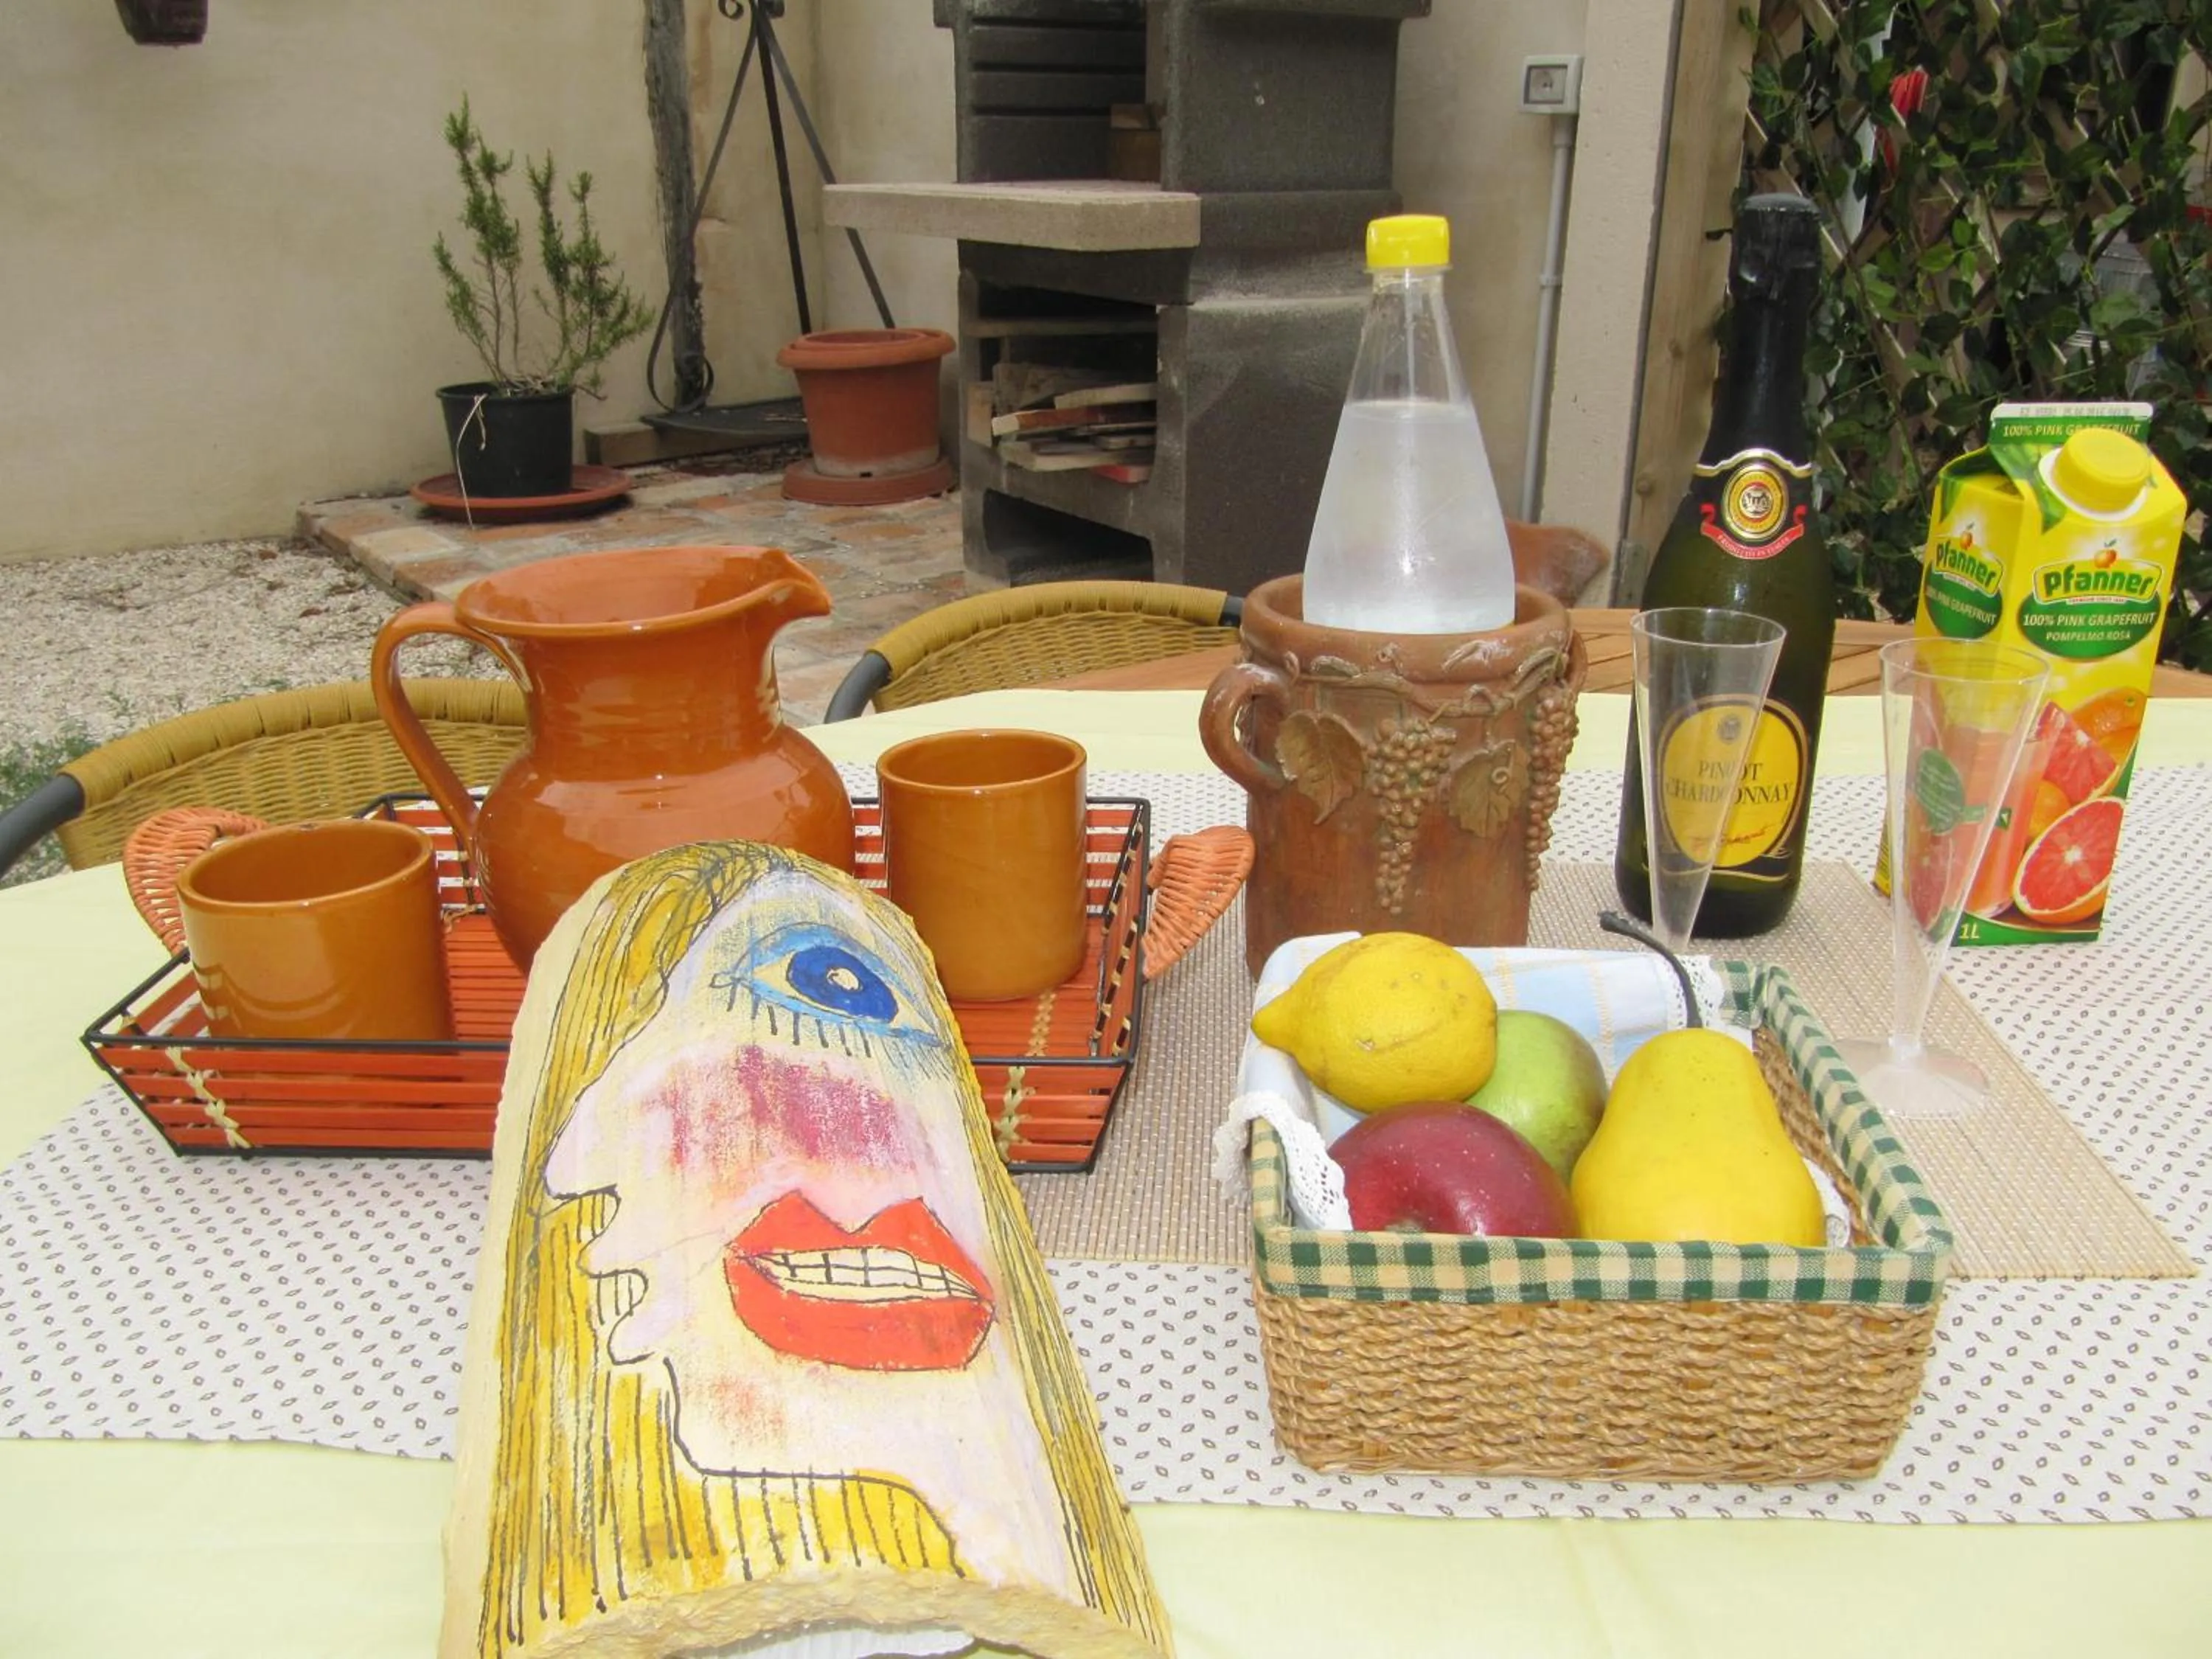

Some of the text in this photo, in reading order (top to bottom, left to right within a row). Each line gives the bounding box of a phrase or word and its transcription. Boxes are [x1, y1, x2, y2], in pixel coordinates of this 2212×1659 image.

[2034, 424, 2062, 437] PINK
[1935, 540, 1997, 588] pfanner
[2043, 563, 2154, 597] pfanner
[2023, 611, 2157, 627] 100% PINK GRAPEFRUIT
[2046, 630, 2132, 641] POMPELMO ROSA
[1959, 924, 1980, 939] 1L
